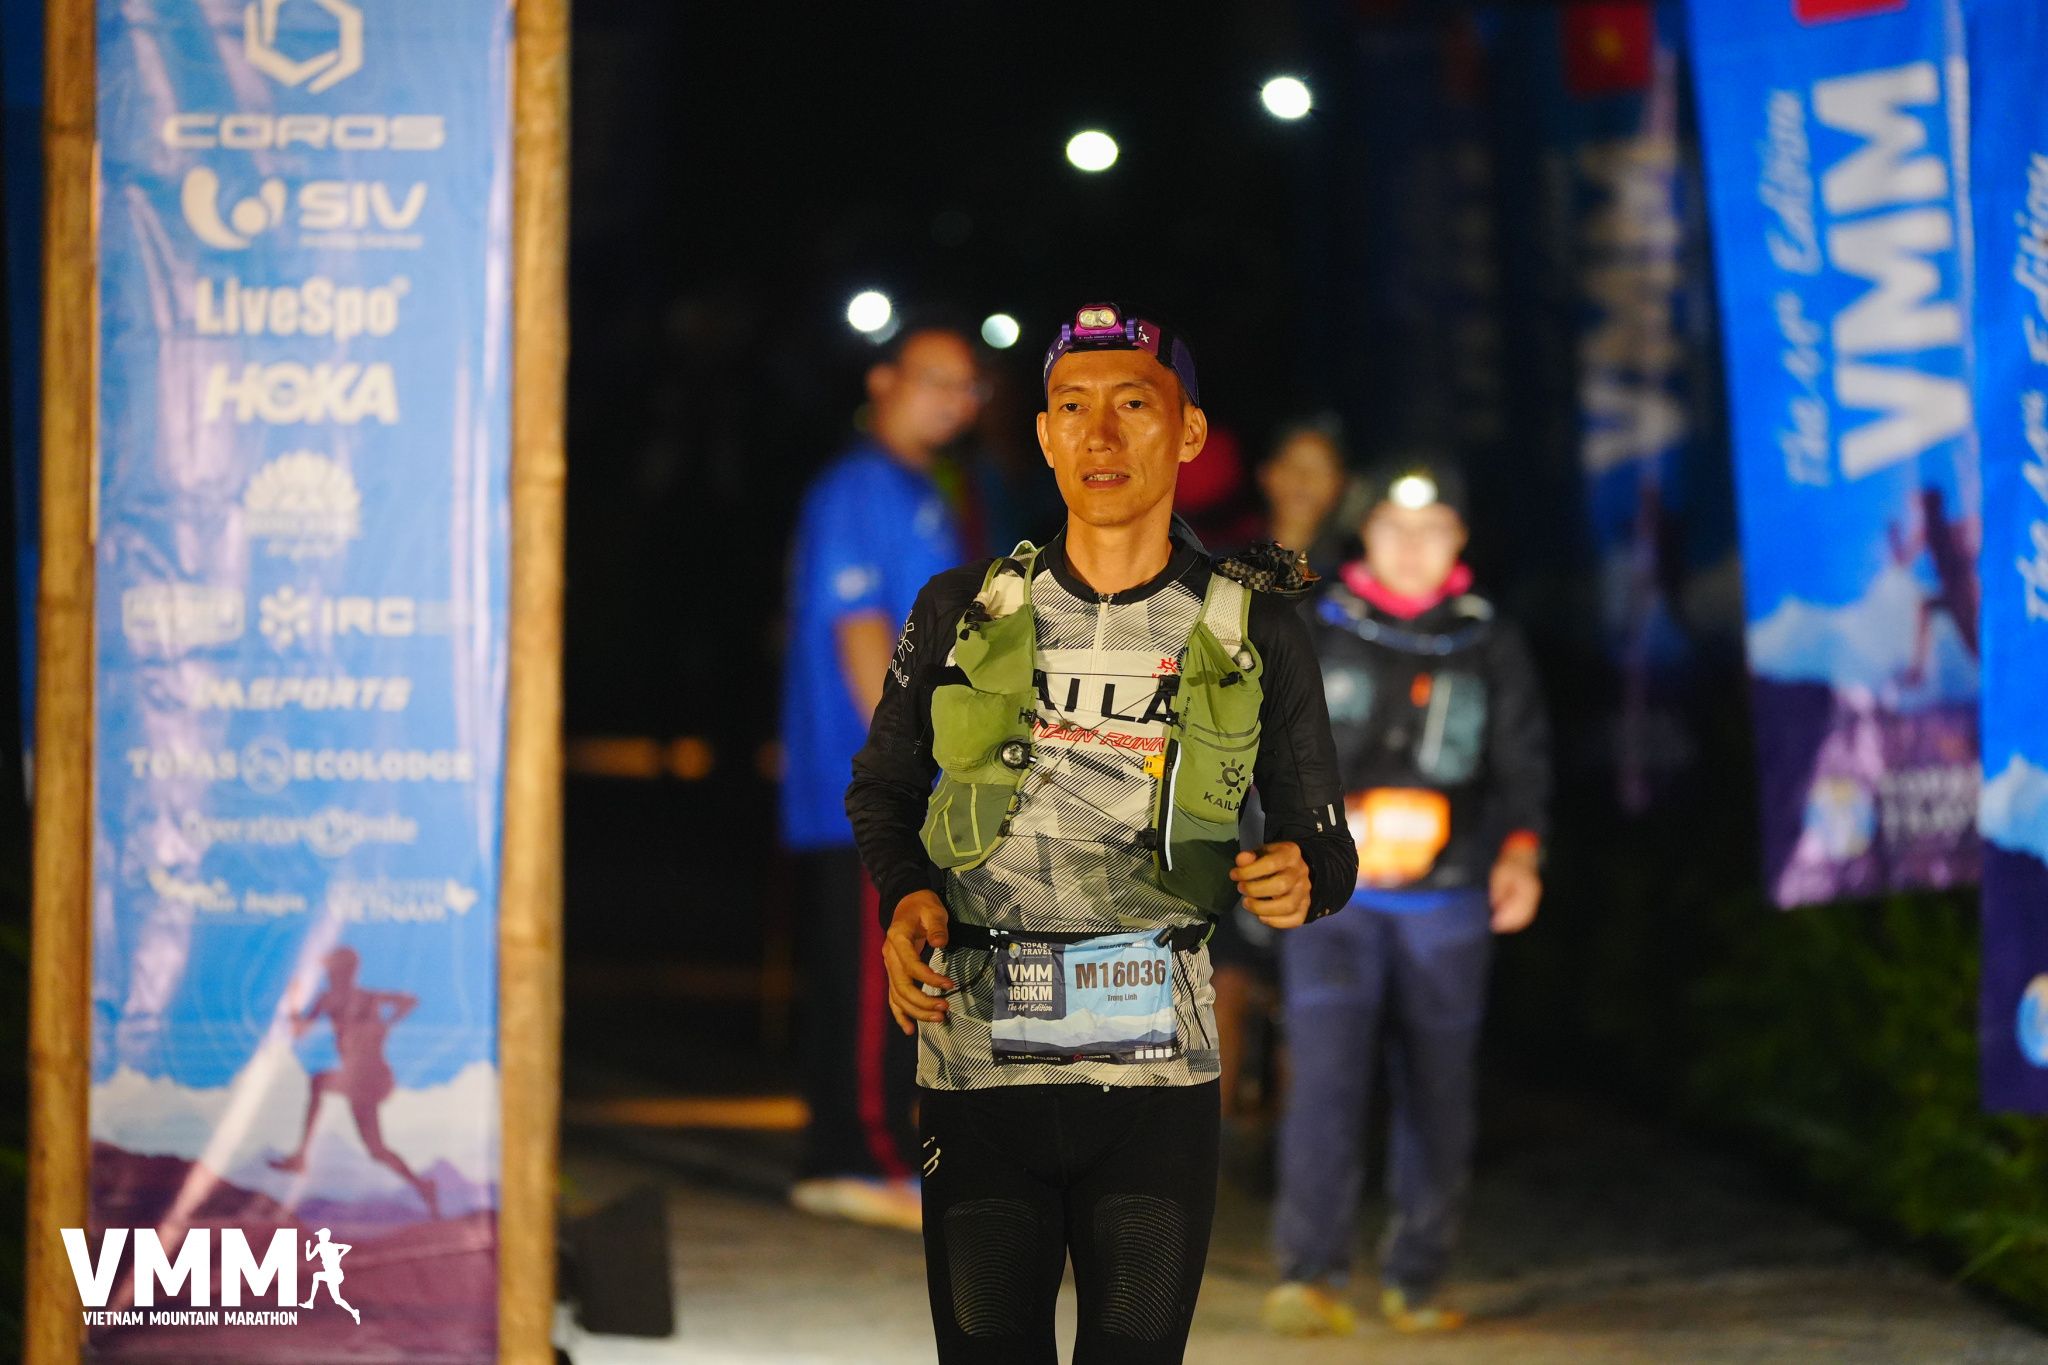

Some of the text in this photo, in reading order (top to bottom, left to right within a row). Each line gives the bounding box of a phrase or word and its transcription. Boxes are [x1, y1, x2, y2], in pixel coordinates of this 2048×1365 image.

[163, 114, 446, 150] COROS
[299, 181, 428, 230] SIV
[1812, 61, 1970, 480] VMM
[203, 361, 400, 424] HOKA
[1008, 964, 1053, 981] VMM
[1075, 959, 1167, 989] M16036
[1007, 985, 1053, 1001] 160KM
